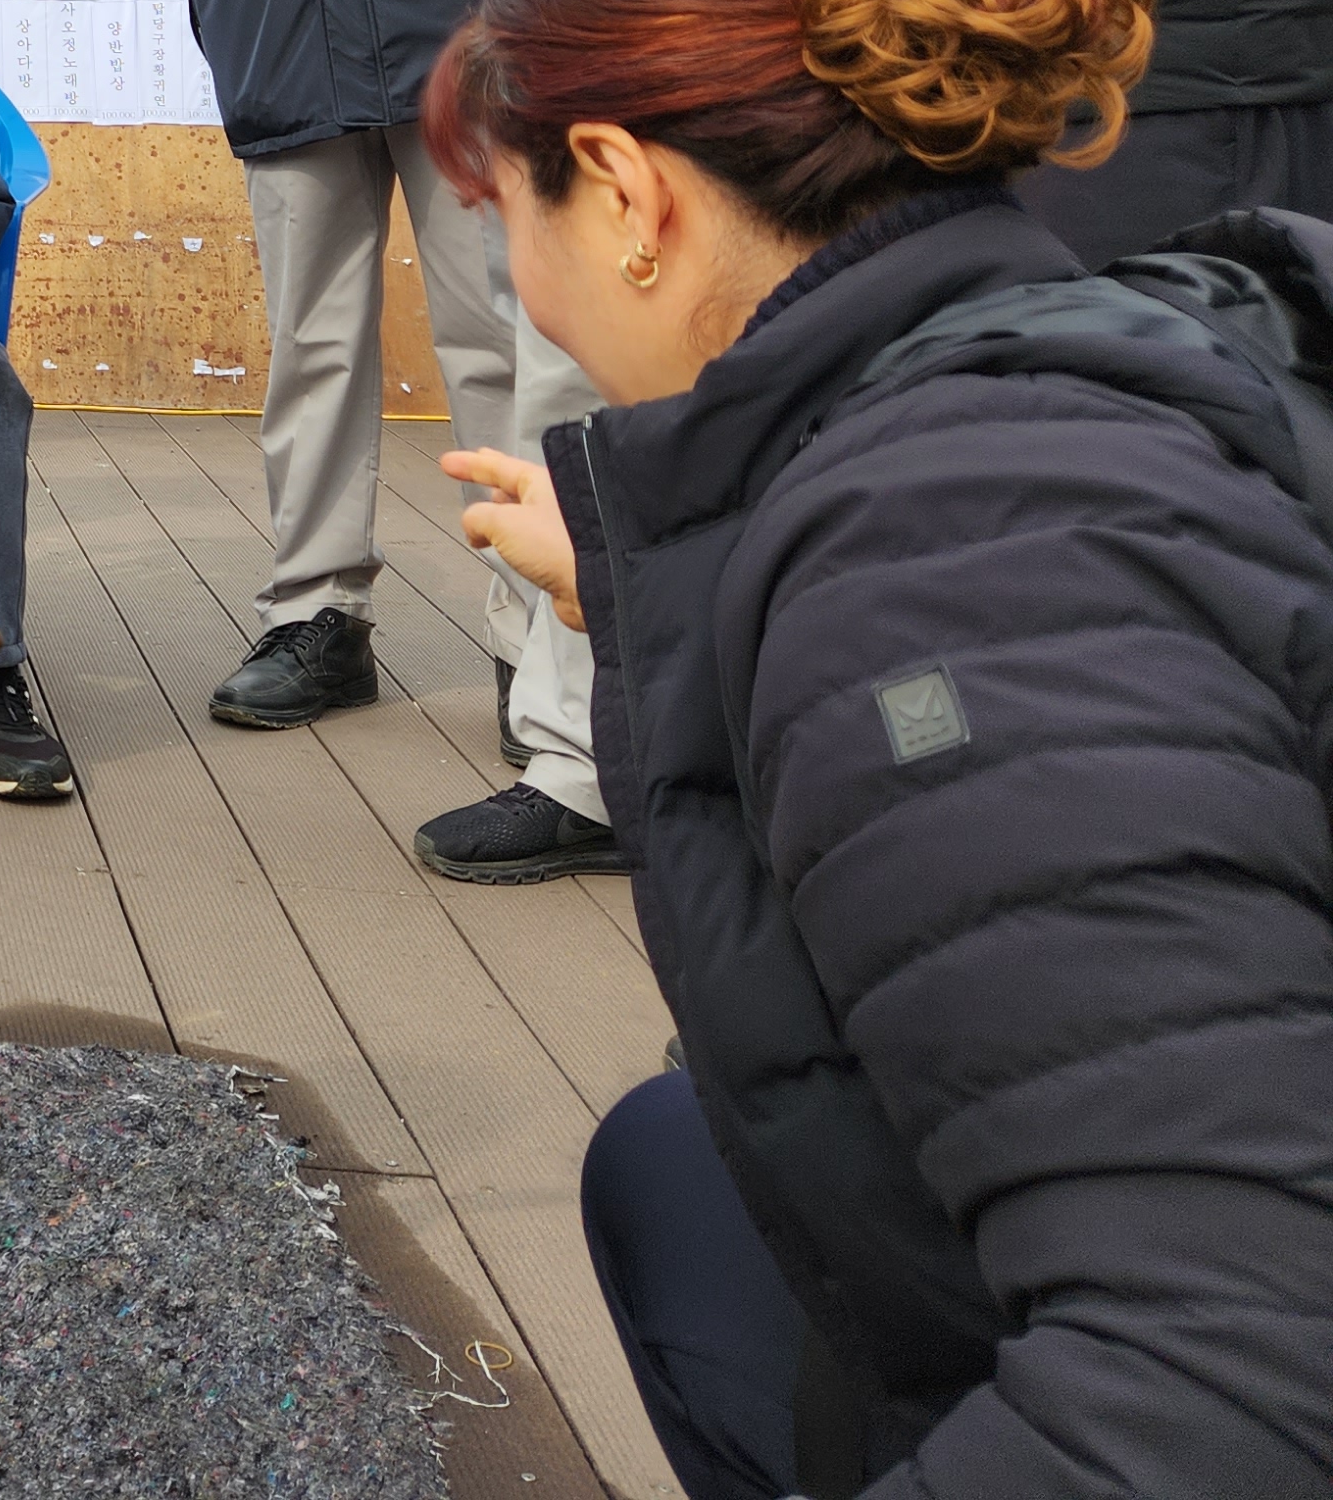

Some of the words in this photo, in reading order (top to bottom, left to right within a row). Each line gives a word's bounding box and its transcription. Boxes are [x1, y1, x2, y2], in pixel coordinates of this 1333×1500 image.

[16, 18, 33, 89] 상아다방
[60, 2, 80, 106] 사오정노래방
[107, 21, 126, 91] 양반밥상
